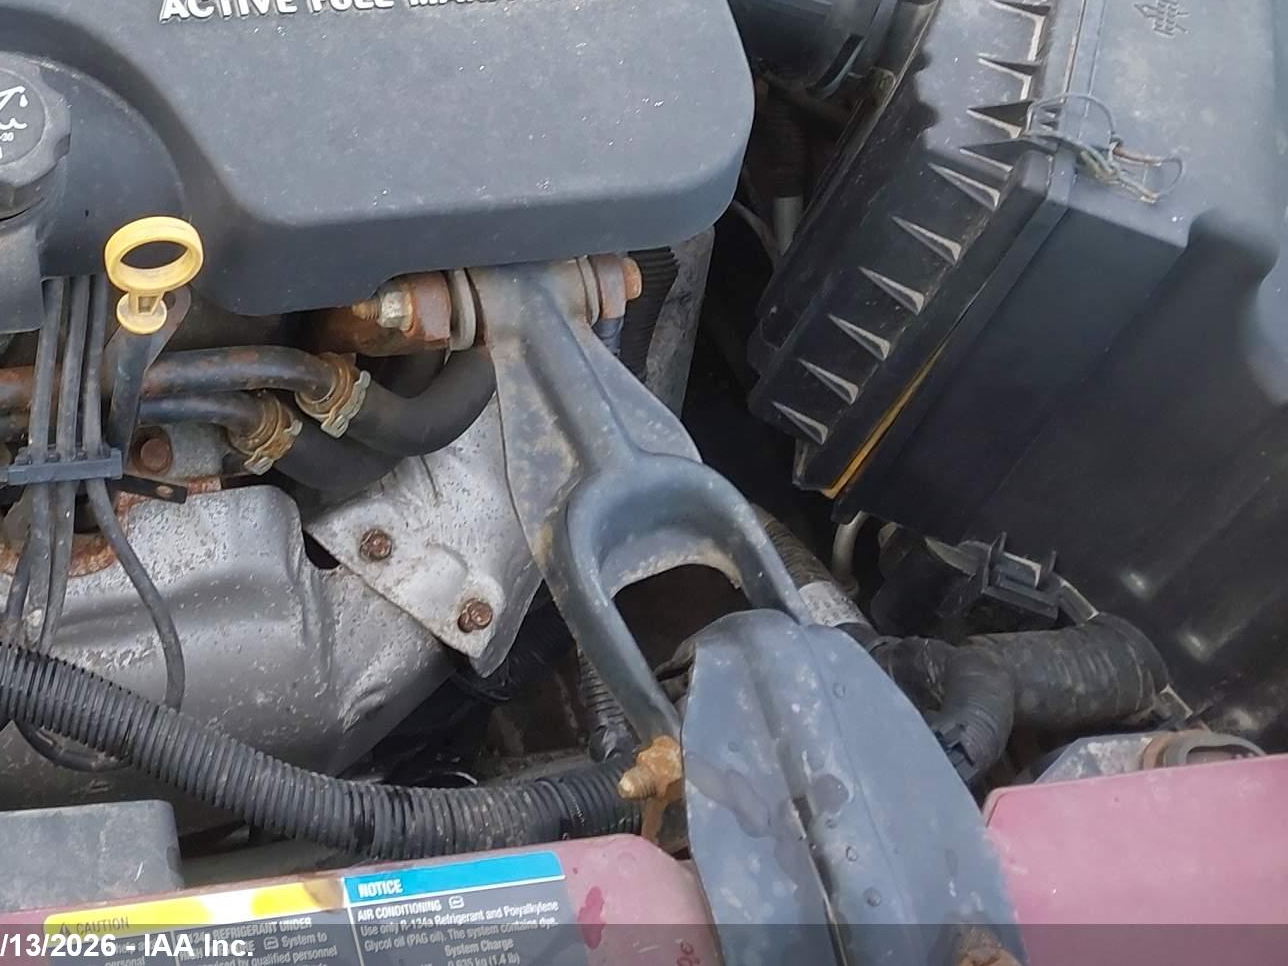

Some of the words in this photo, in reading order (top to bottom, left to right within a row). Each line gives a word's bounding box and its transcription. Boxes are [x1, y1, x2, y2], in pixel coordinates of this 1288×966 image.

[357, 879, 404, 898] NOTICE
[357, 908, 374, 922] AIR
[375, 899, 442, 919] CONDITIONING
[360, 925, 379, 936] Use
[380, 922, 399, 935] only
[400, 917, 433, 931] R-134a
[434, 909, 485, 926] Refrigerant
[486, 907, 504, 920] and
[504, 901, 559, 918] Polyalkylene
[75, 916, 130, 936] CAUTION
[212, 922, 278, 941] REFRIGERANT
[279, 917, 312, 932] UNDER
[364, 937, 392, 953] Glycol
[393, 935, 406, 948] oil
[407, 932, 429, 947] (PAG
[447, 929, 466, 941] The
[467, 925, 500, 940] system
[501, 918, 538, 933] contains
[281, 934, 316, 950] System
[317, 932, 328, 943] to
[444, 941, 479, 958] System
[480, 938, 514, 951] Charge
[292, 945, 338, 964] personnel
